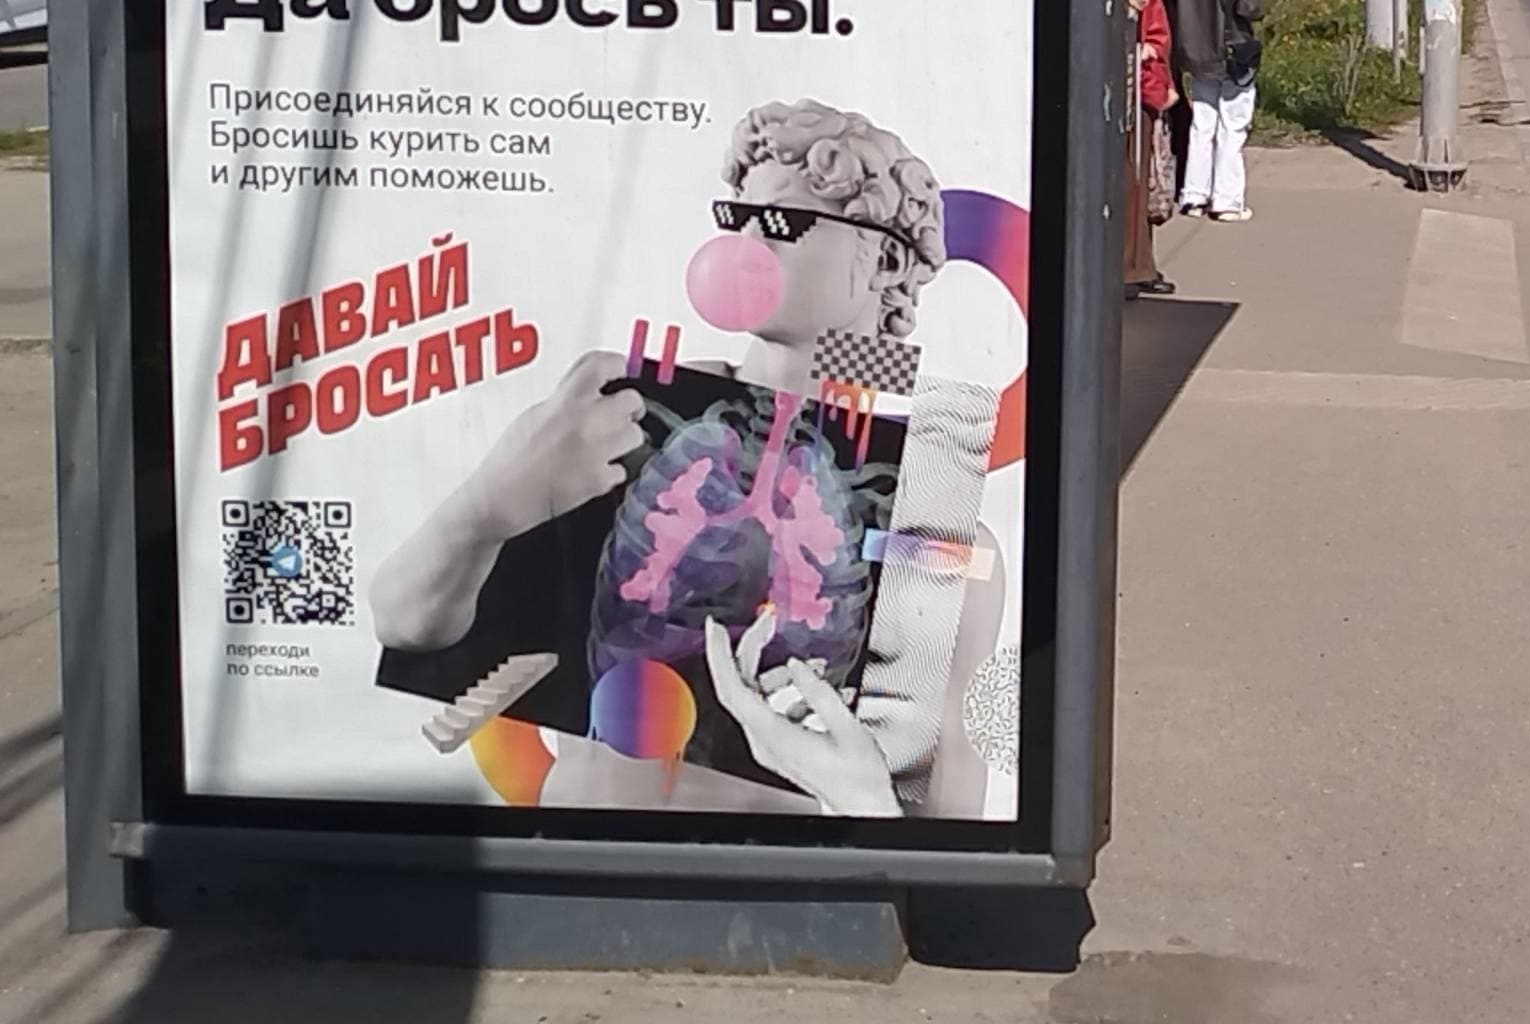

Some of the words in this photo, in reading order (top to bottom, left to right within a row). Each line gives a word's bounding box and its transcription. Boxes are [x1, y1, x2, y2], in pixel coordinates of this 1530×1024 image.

[209, 84, 472, 118] Присоединяйся
[482, 95, 499, 116] к
[510, 95, 712, 129] сообществу.
[210, 122, 359, 155] Бросишь
[370, 131, 480, 157] курить
[490, 133, 551, 155] сам
[210, 165, 229, 184] и
[240, 164, 359, 192] другим
[370, 169, 555, 194] поможешь.
[217, 231, 470, 402] ДАВАЙ
[218, 307, 540, 473] БРОСАТЬ
[226, 644, 310, 659] переходи
[227, 664, 249, 676] по
[254, 664, 320, 677] ссылке
